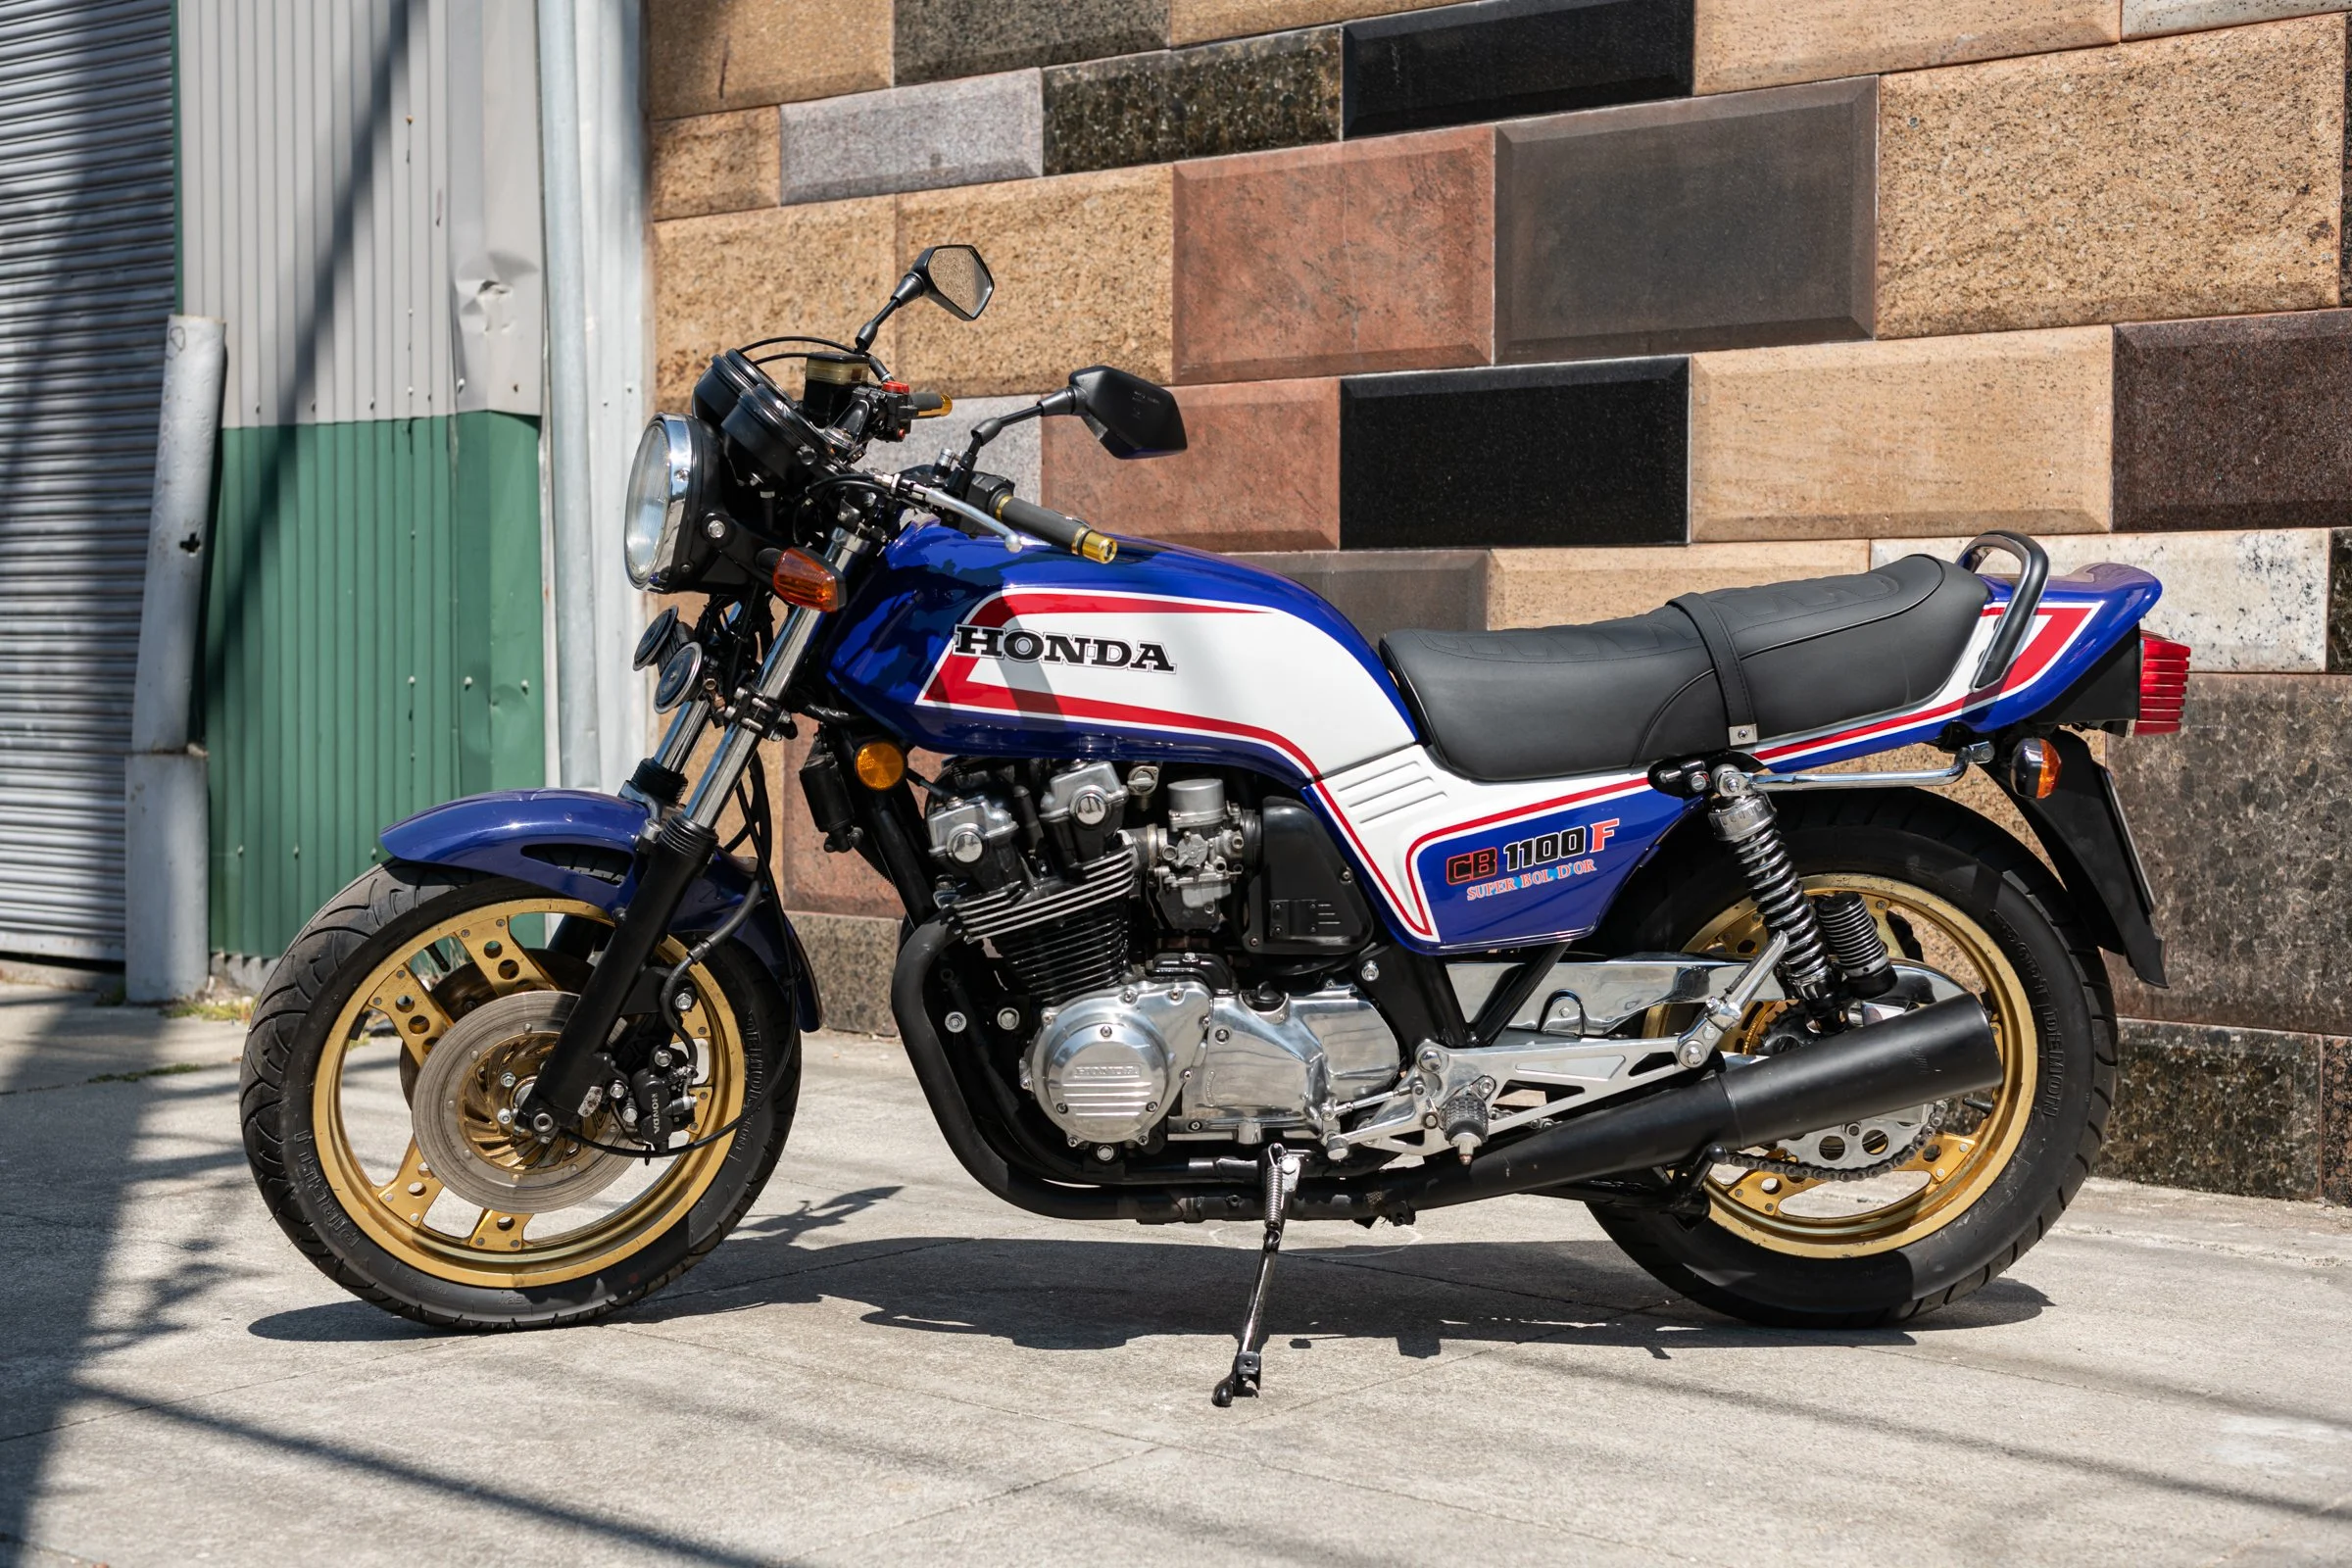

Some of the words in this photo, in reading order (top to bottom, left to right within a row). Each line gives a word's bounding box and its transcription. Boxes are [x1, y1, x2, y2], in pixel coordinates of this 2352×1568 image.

[954, 624, 1176, 673] HONDA
[1446, 847, 1497, 886] CB
[1467, 878, 1515, 901] SUPER
[1520, 871, 1553, 888] BOL
[1557, 858, 1597, 879] D'OR
[651, 1092, 661, 1134] HONDA
